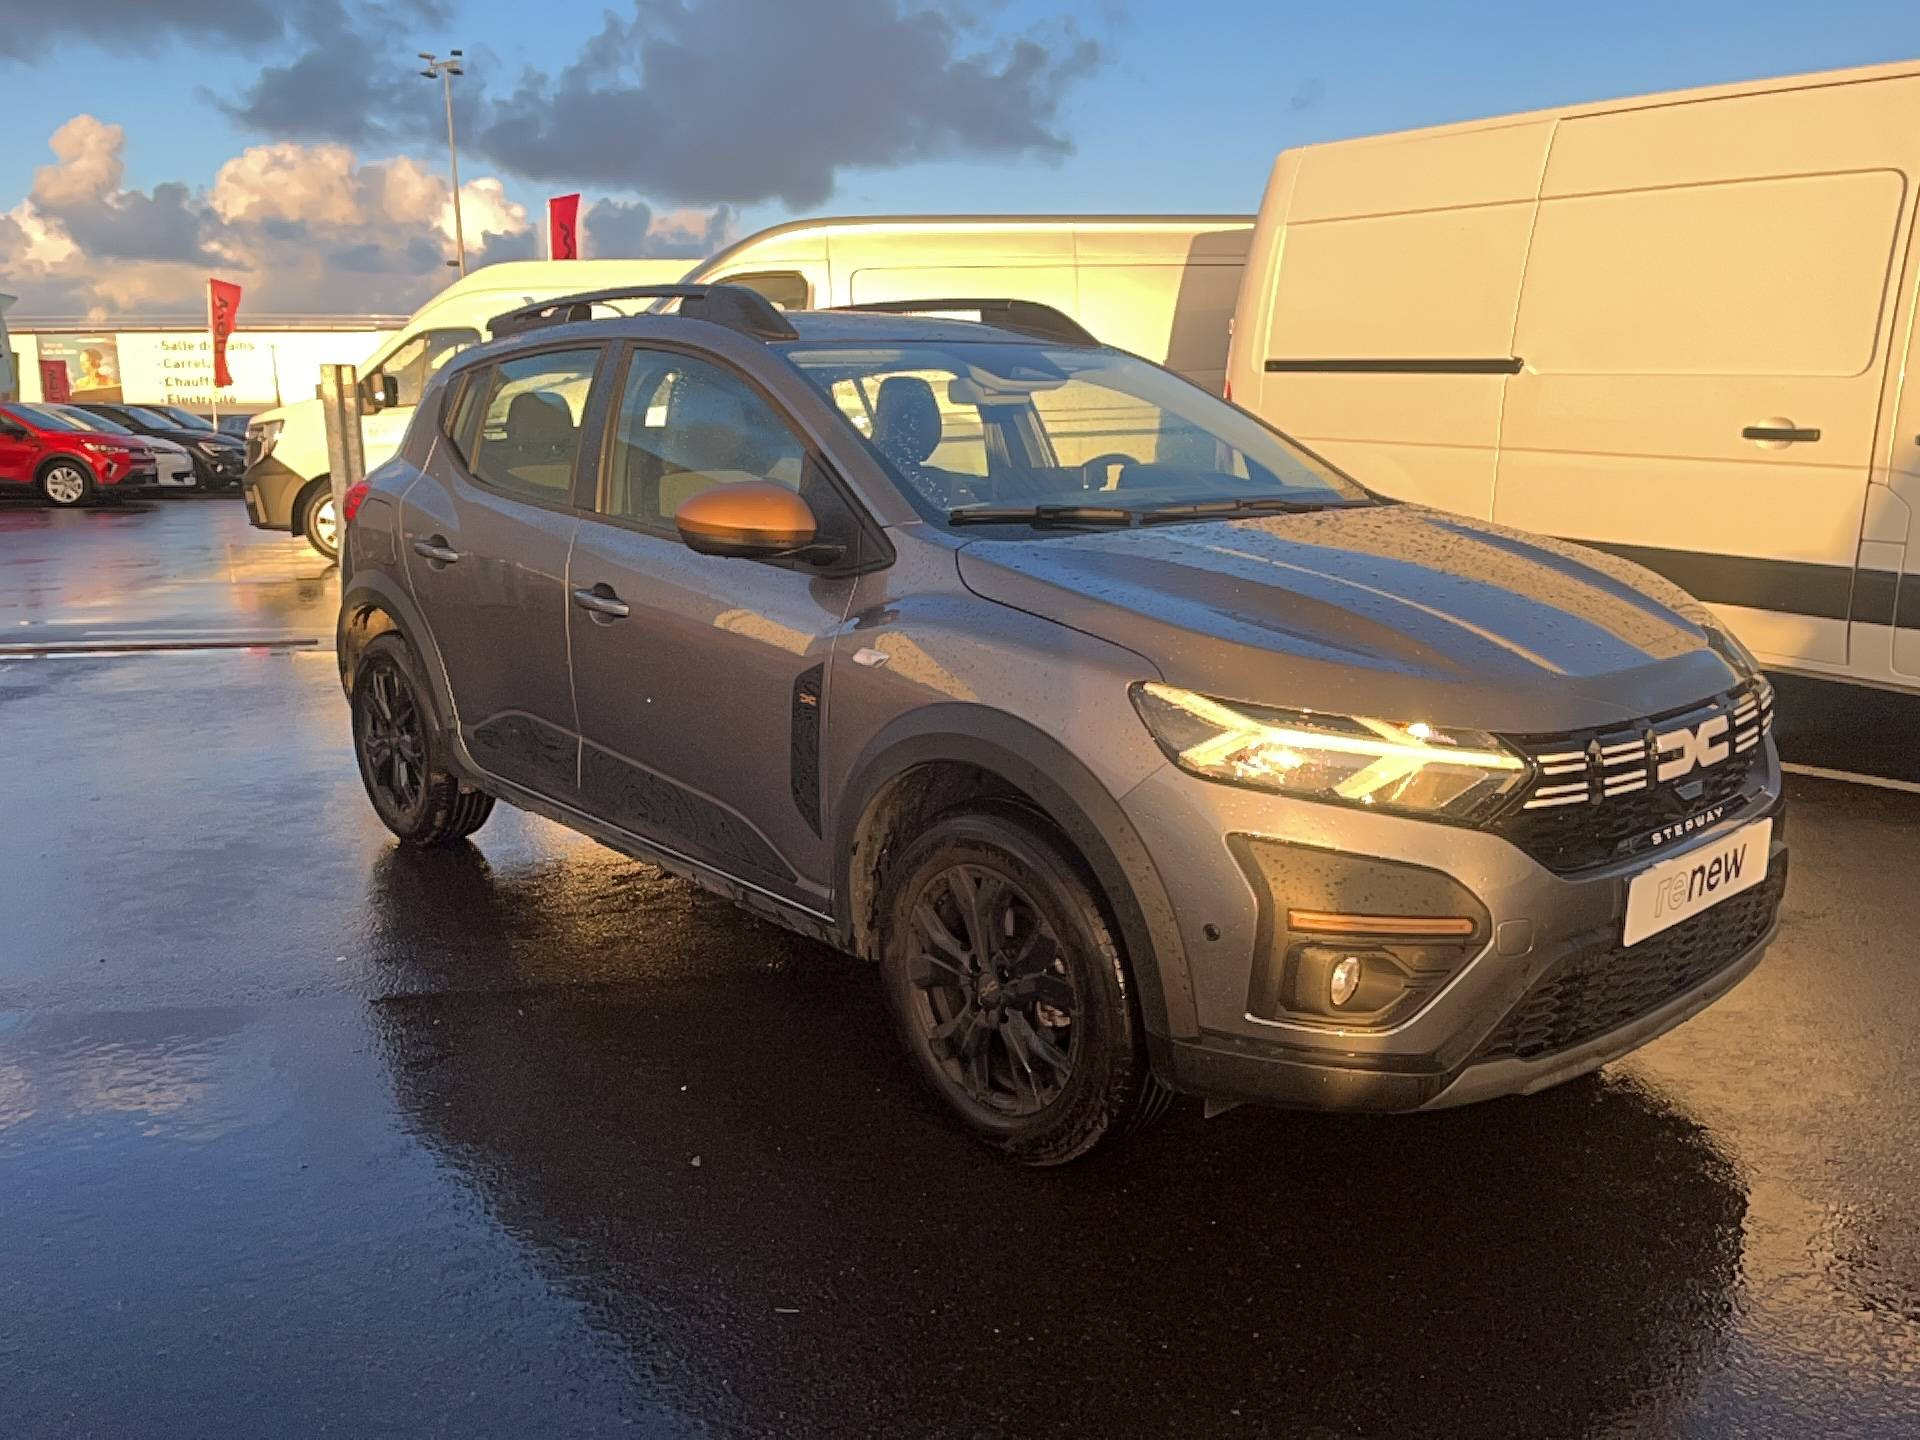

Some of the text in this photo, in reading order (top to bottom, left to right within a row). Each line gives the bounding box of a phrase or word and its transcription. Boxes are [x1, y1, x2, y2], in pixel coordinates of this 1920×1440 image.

[163, 358, 212, 369] Carrel
[164, 376, 213, 387] Chauff
[1651, 806, 1724, 846] STEPWAY
[1654, 843, 1748, 919] renew
